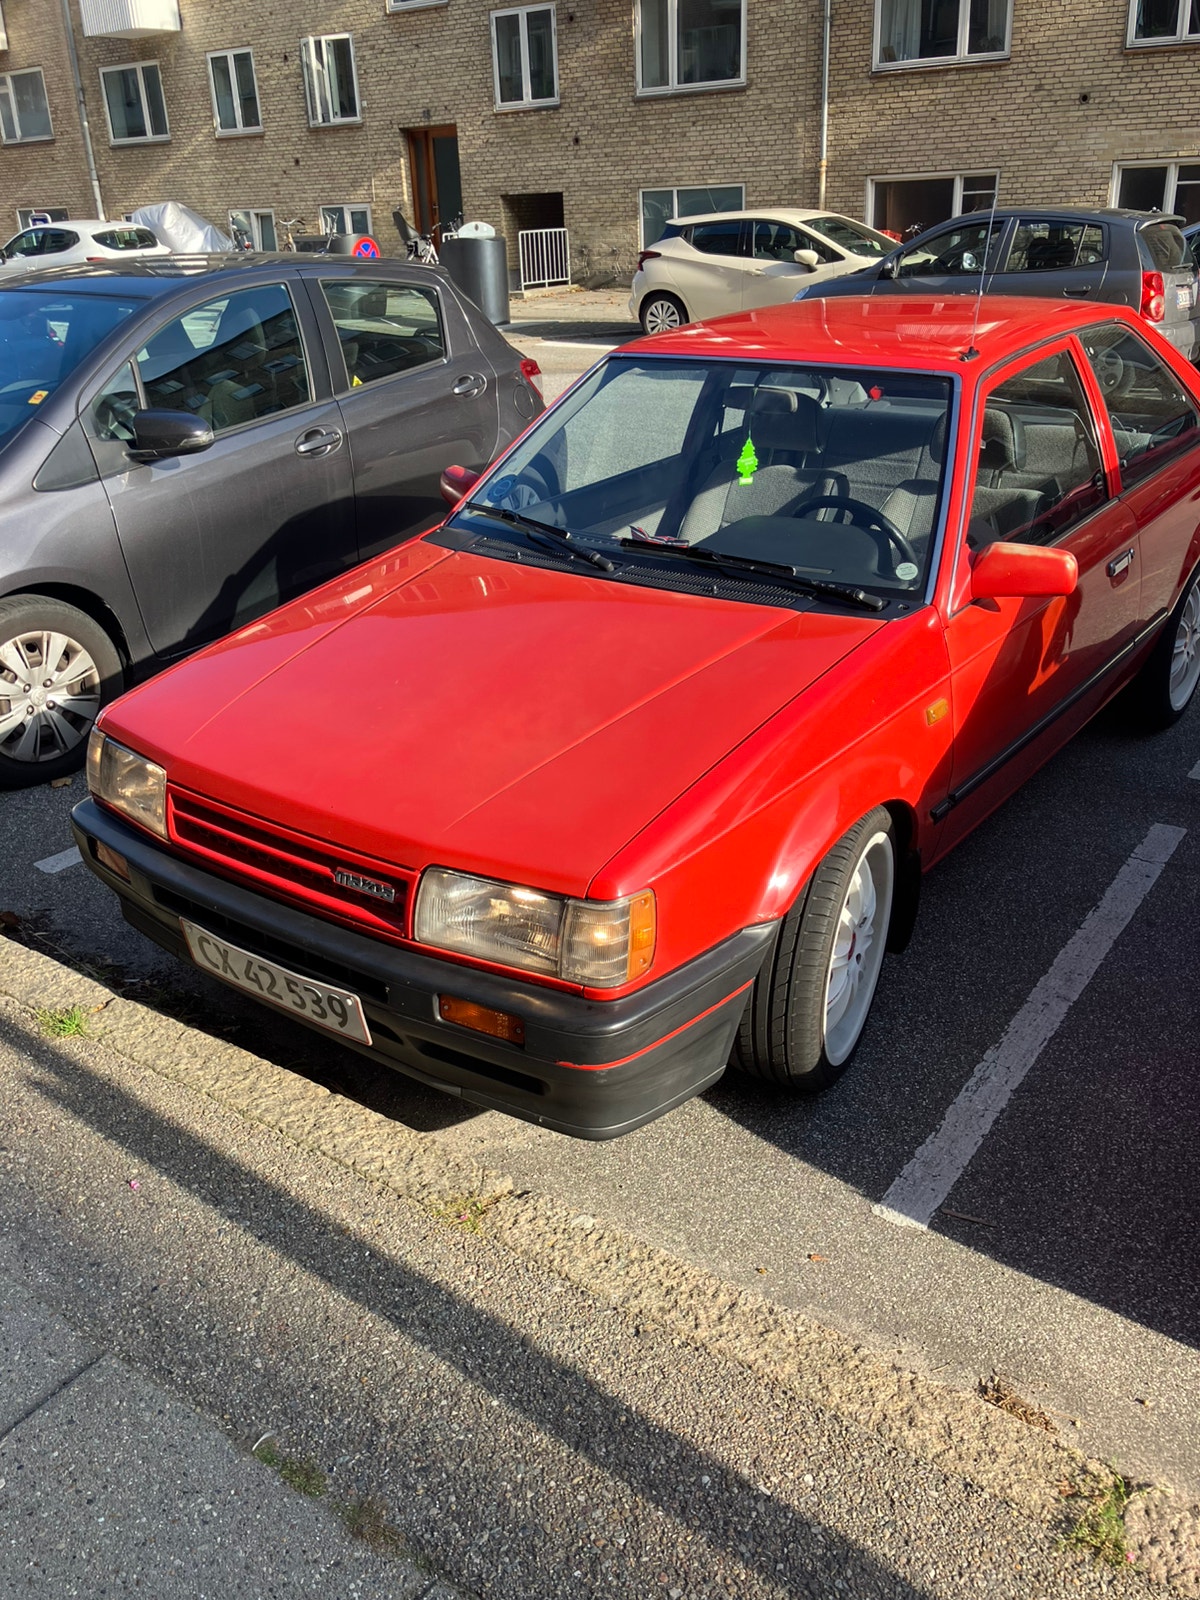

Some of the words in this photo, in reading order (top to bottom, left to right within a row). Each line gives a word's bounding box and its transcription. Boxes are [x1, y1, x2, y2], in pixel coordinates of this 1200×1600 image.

[197, 936, 240, 980] CX
[244, 960, 283, 1000] 42
[285, 979, 349, 1028] 539
